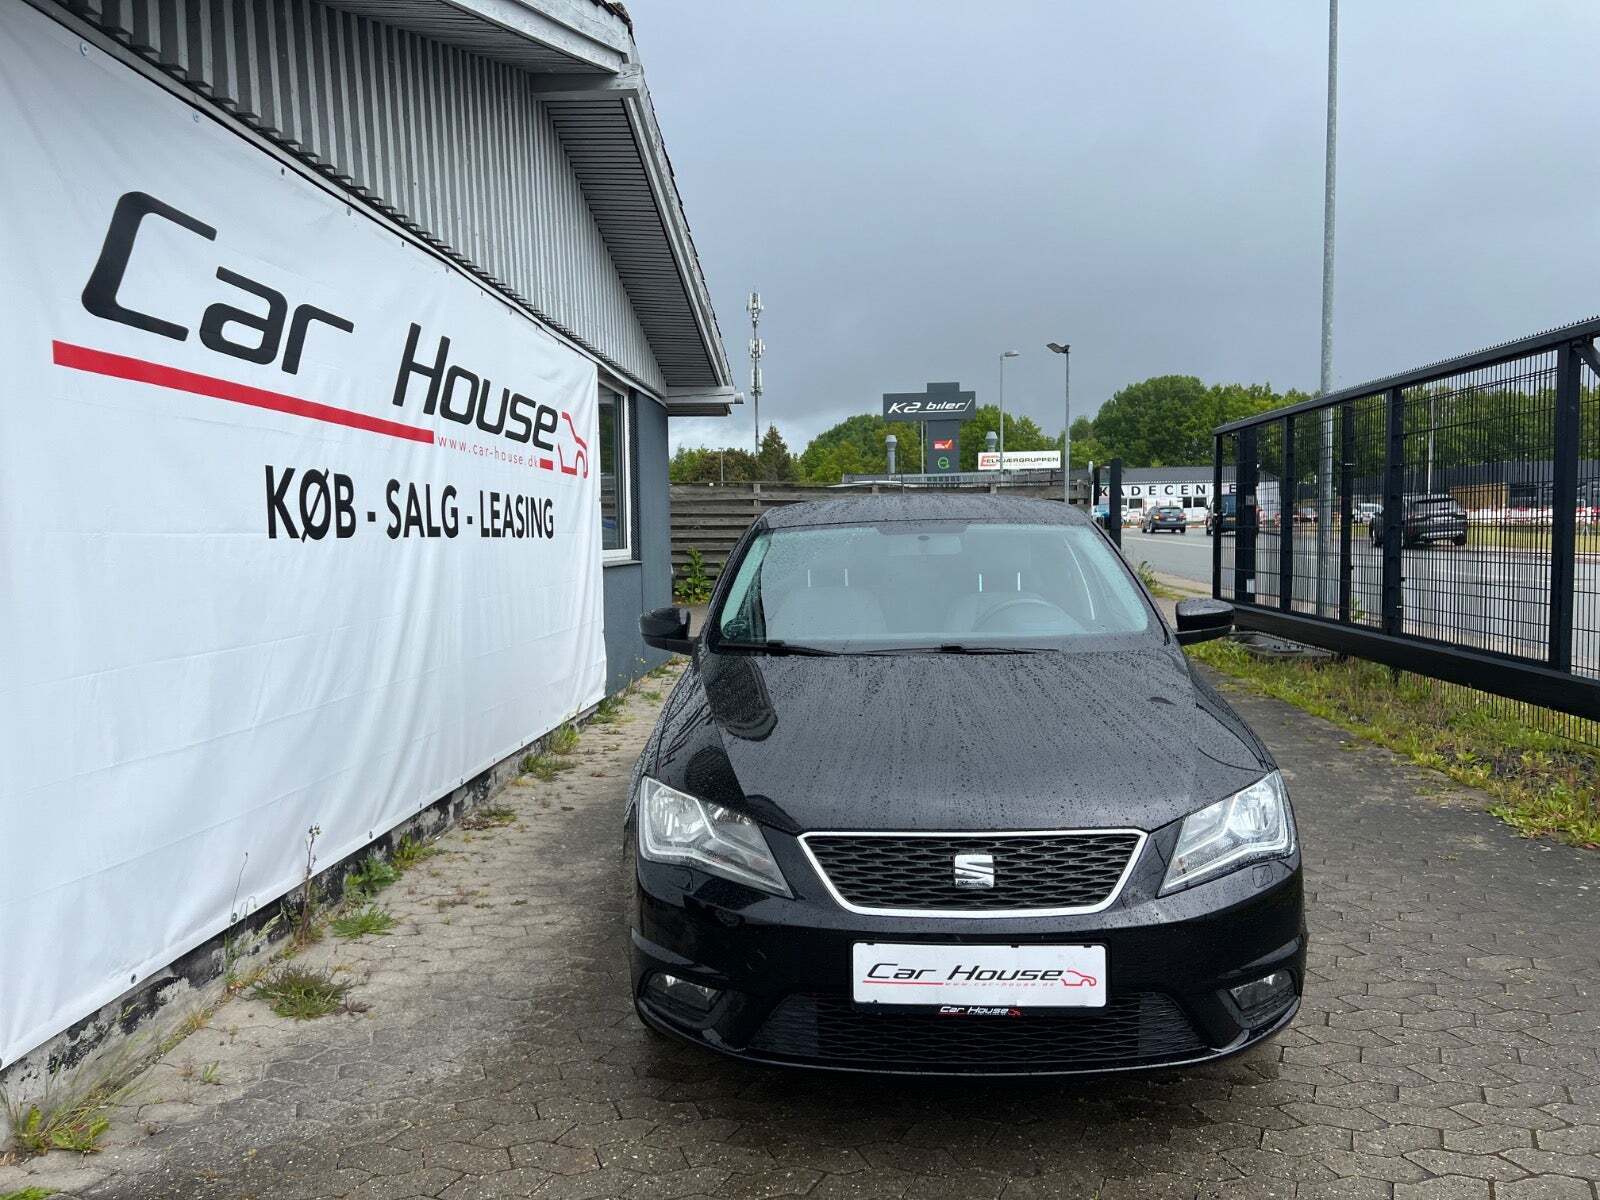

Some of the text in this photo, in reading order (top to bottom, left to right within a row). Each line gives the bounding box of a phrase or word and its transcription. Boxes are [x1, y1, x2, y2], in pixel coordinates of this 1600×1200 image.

[81, 191, 559, 452] Car House
[888, 401, 965, 414] K2 biler
[437, 436, 538, 469] www.car-house.dk
[265, 464, 357, 544] KØB
[386, 478, 459, 540] SALG
[480, 490, 554, 540] LEASING
[867, 963, 1064, 981] Car House
[967, 1006, 1010, 1015] House
